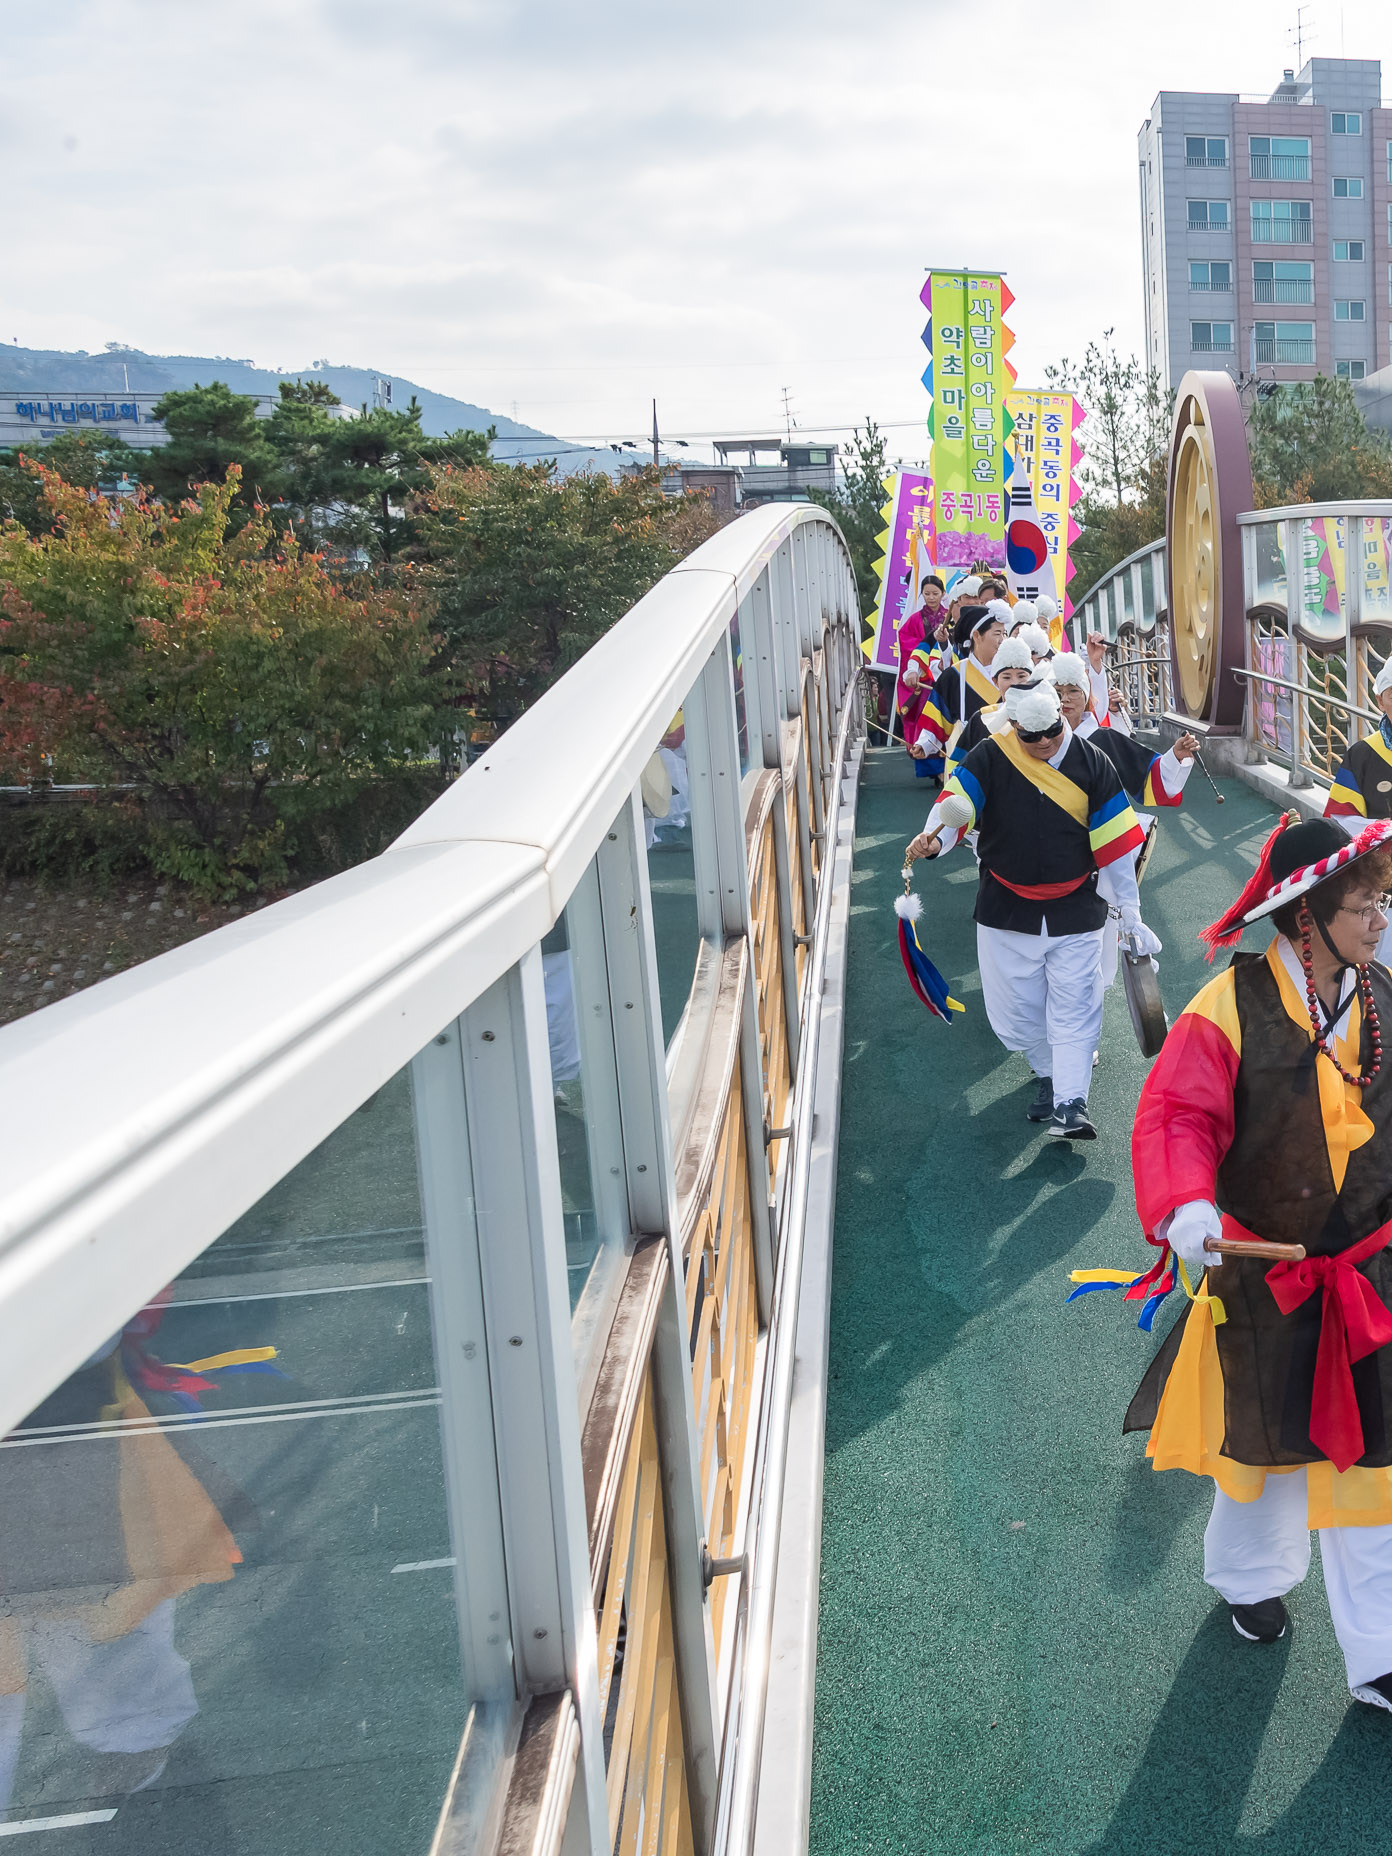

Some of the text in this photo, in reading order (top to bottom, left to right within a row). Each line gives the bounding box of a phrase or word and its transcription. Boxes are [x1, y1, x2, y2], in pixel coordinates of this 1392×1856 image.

[16, 402, 140, 424] 하나님의교회
[940, 326, 966, 439] 약초 마을
[968, 299, 997, 482] 사람이 아름다운
[940, 491, 1001, 522] 중곡1동
[1040, 413, 1064, 555] 중곡동의 중심
